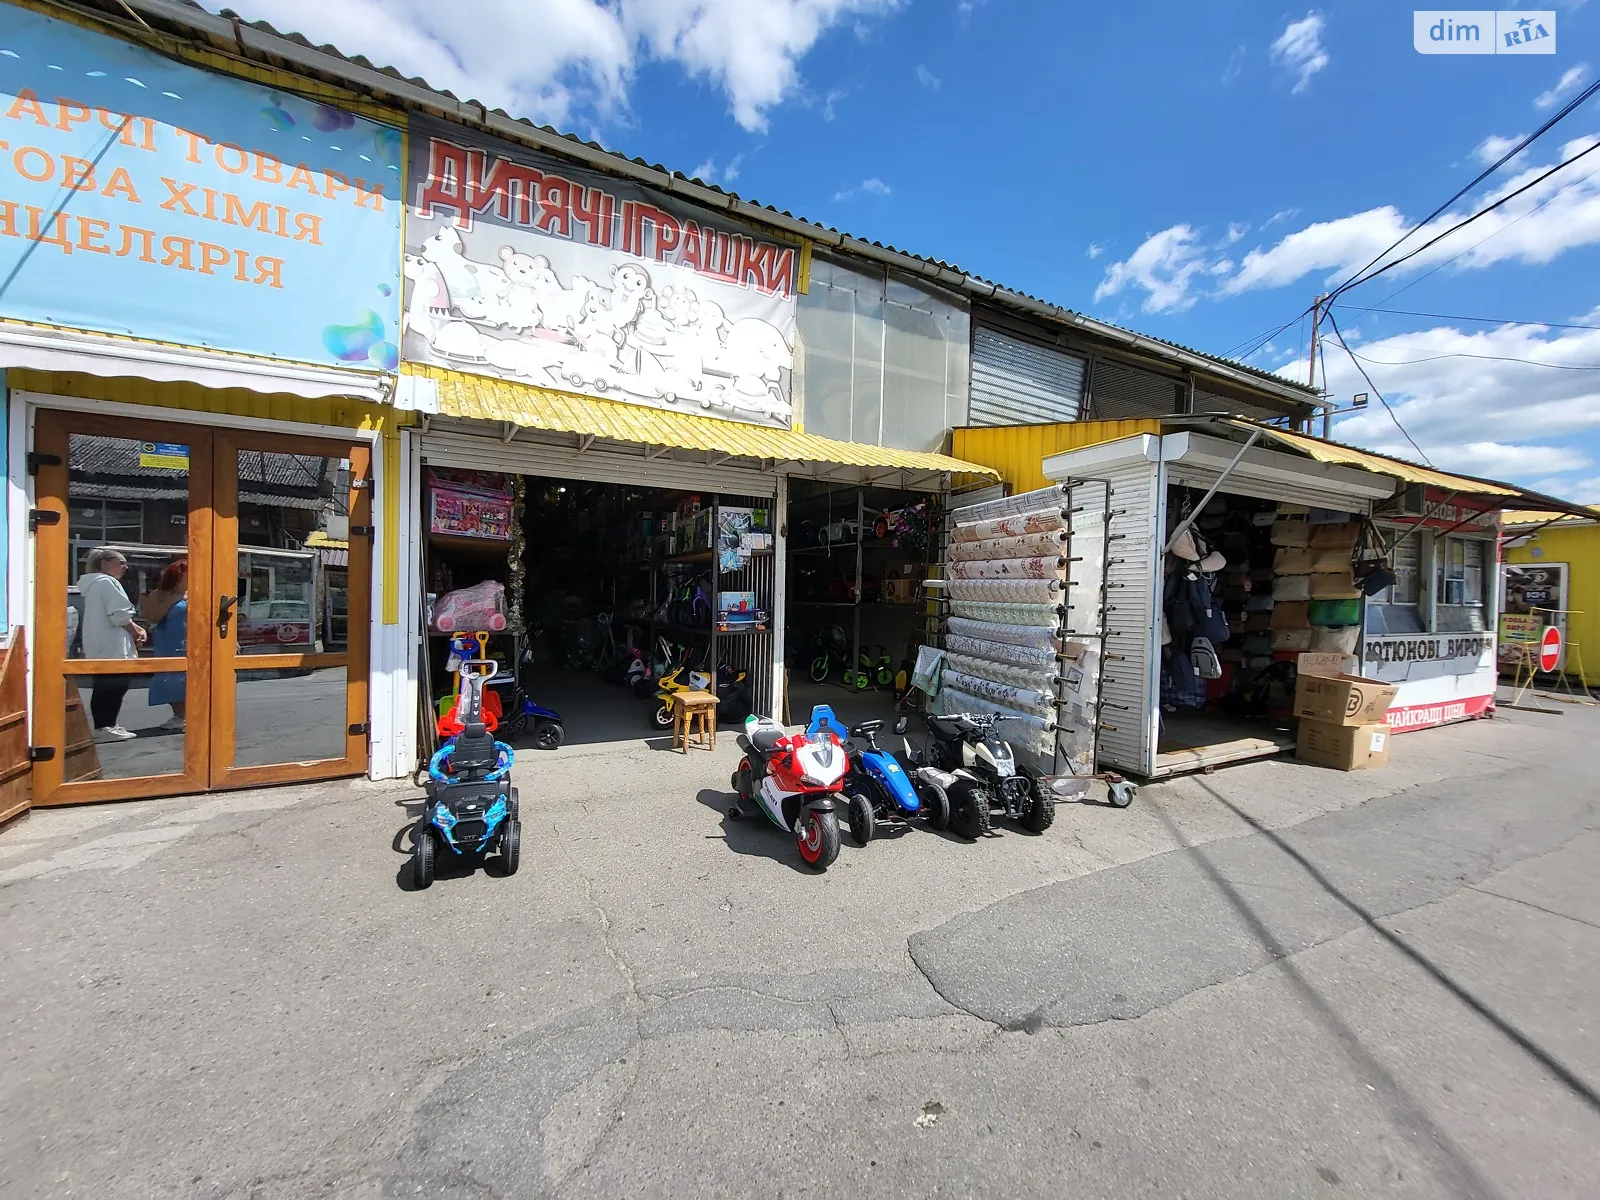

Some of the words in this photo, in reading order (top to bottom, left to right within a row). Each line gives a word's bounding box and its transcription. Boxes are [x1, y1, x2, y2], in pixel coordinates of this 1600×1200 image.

[5, 88, 157, 152] АРЧІ
[176, 126, 386, 212] ТОВАРИ
[160, 177, 324, 246] ХІМІЯ
[416, 138, 614, 249] ДИТЯЧІ
[620, 199, 795, 302] ІГРАШКИ
